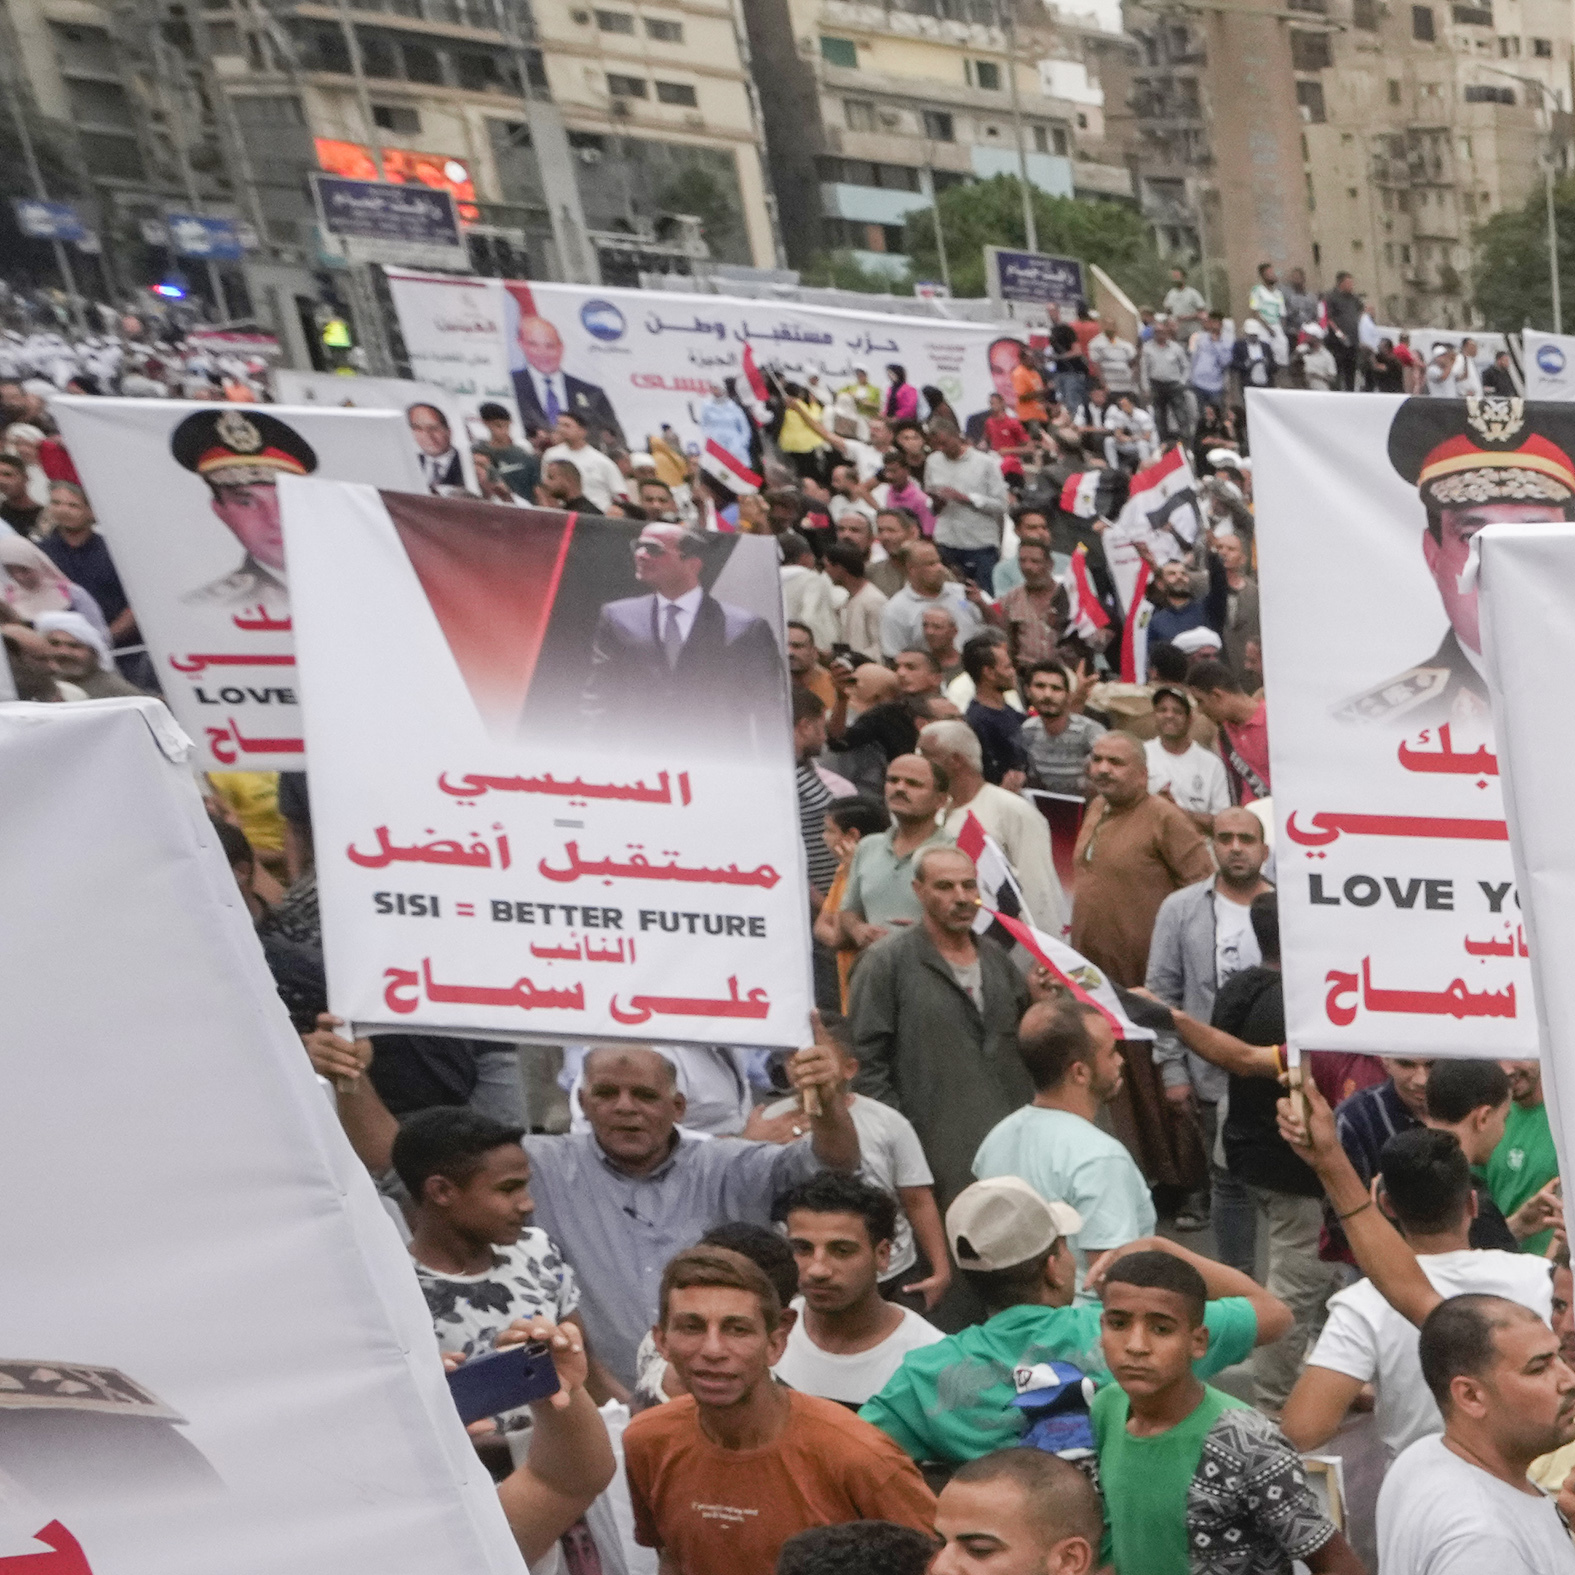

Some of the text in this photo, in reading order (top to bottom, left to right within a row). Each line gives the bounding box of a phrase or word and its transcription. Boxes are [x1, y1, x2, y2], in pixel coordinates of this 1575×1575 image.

[644, 310, 899, 354] حزب مستقبل وطن
[193, 686, 298, 706] LOVE
[436, 769, 694, 808] السيسي
[346, 822, 784, 891] مستقبل أفضل
[1307, 873, 1455, 912] LOVE
[372, 891, 442, 919] SISI
[490, 897, 625, 932] BETTER
[638, 908, 768, 939] FUTURE
[528, 932, 637, 966] النائب
[381, 957, 773, 1025] على سماح
[1324, 954, 1518, 1027] سماح
